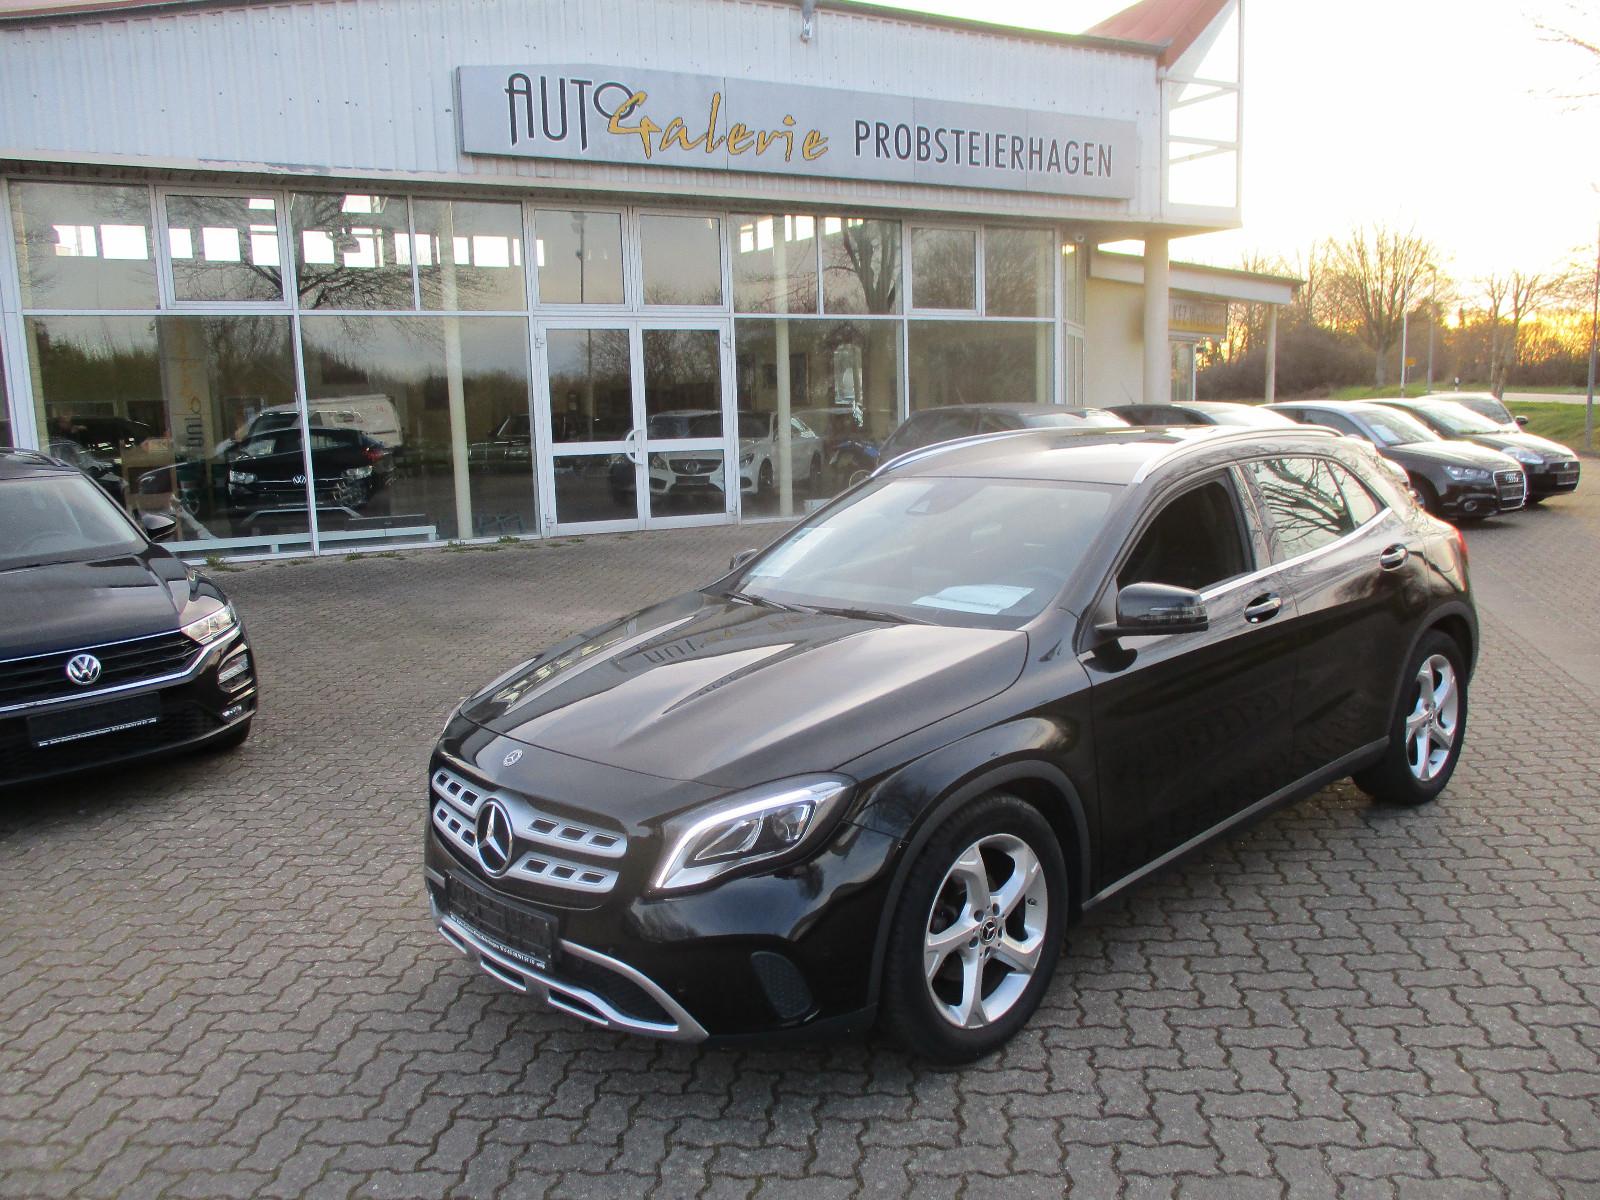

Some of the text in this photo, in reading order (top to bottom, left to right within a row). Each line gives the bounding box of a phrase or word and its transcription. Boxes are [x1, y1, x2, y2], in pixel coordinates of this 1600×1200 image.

[504, 72, 1112, 178] AUTO Galerie PROBSTEIERHAGEN
